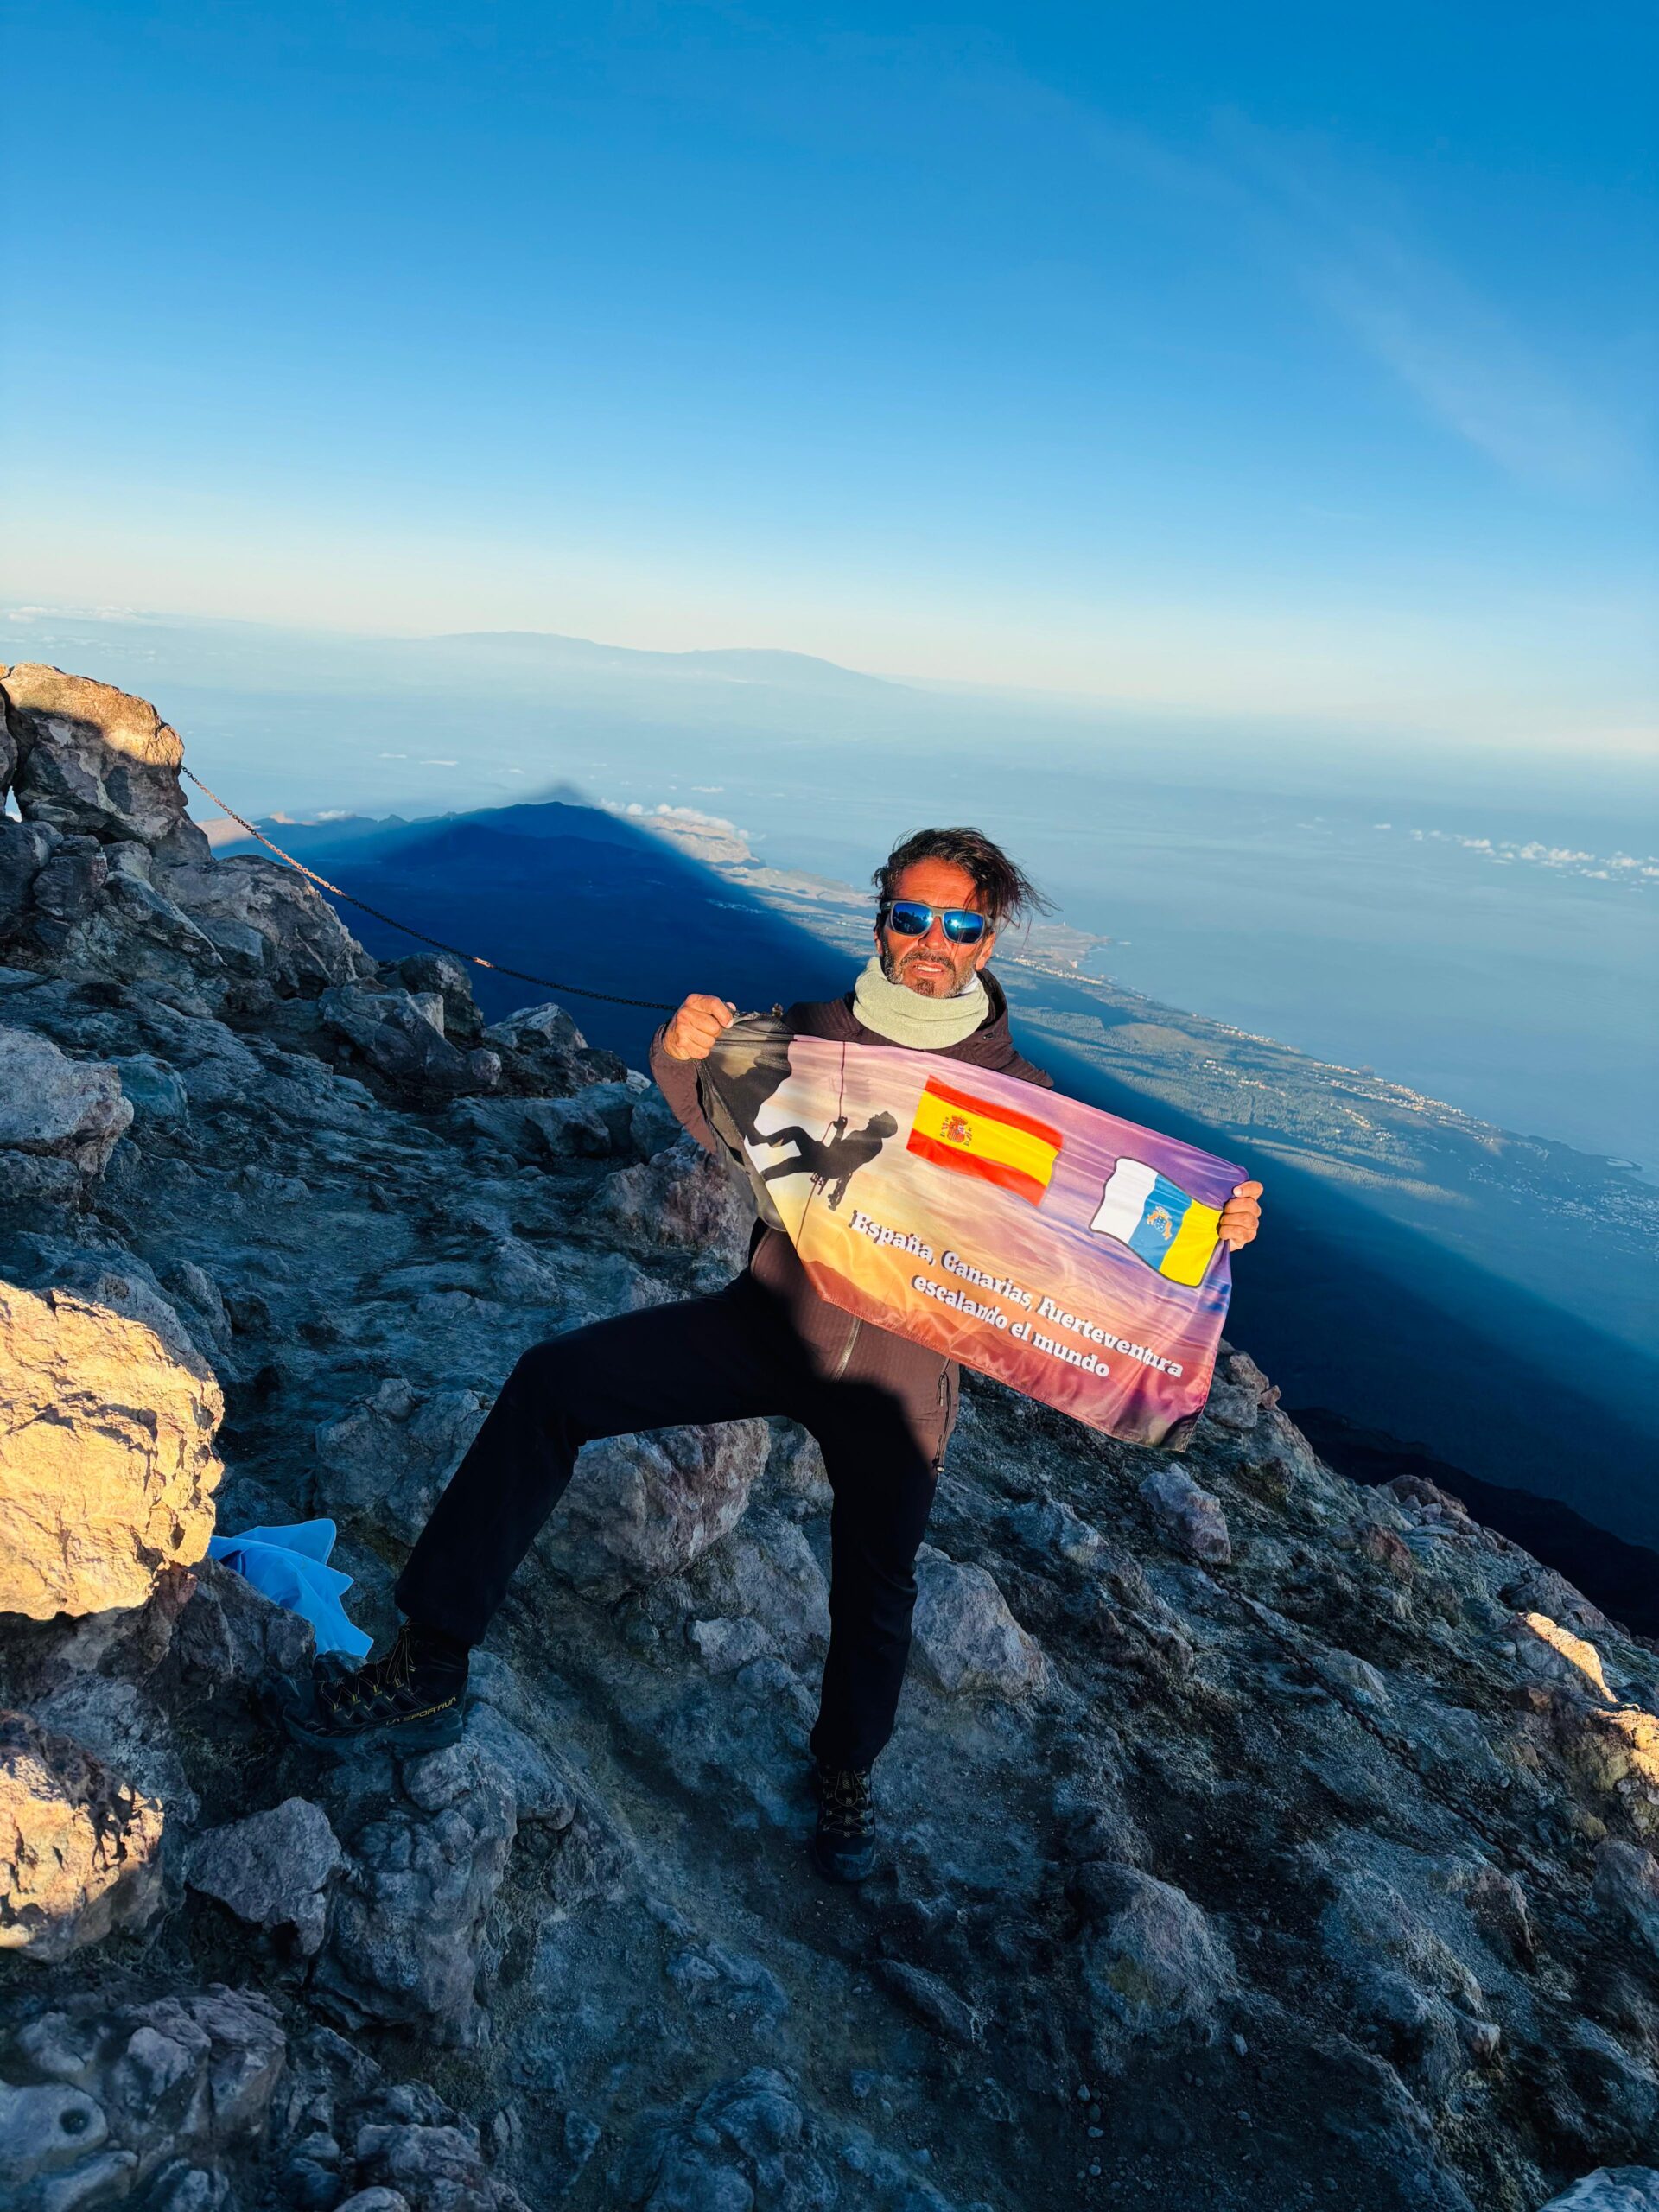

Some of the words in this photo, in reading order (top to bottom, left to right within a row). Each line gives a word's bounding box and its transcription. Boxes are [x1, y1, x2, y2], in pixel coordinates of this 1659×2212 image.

[849, 1210, 937, 1267] España,
[941, 1250, 1034, 1312] Canarias,
[1037, 1296, 1184, 1378] Fuerteventura
[912, 1275, 1008, 1330] escalando
[1009, 1321, 1033, 1342] el
[1033, 1331, 1110, 1377] mundo
[402, 1695, 458, 1722] SPORTIVA
